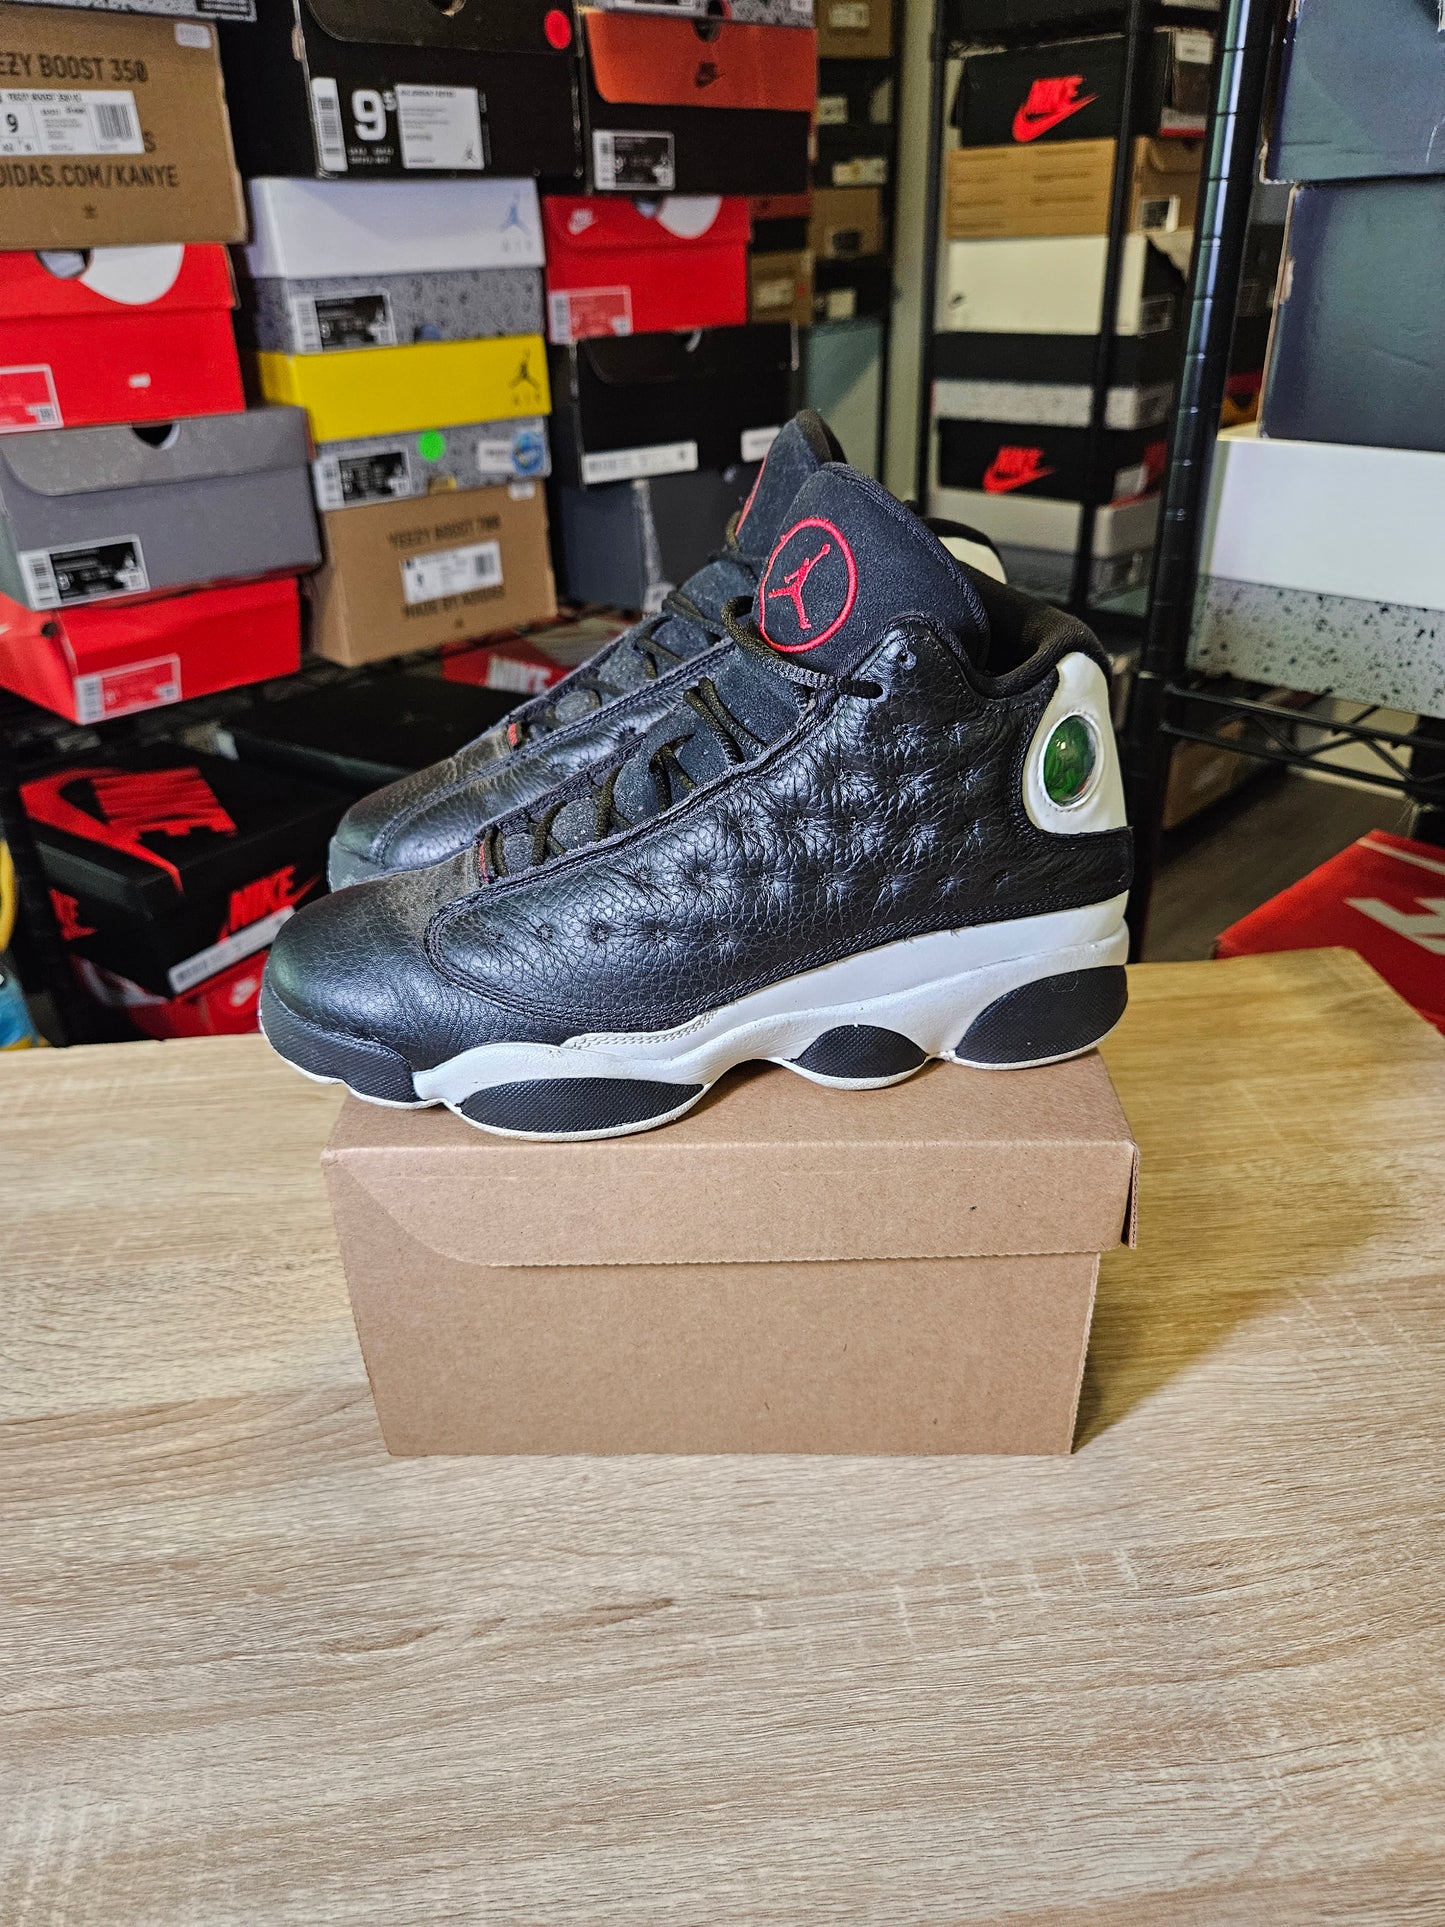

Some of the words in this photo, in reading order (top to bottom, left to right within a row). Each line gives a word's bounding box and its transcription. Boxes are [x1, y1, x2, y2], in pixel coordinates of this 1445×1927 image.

[39, 55, 103, 81] BOOST
[110, 58, 149, 83] 350
[5, 113, 19, 134] 9
[352, 89, 387, 141] 9
